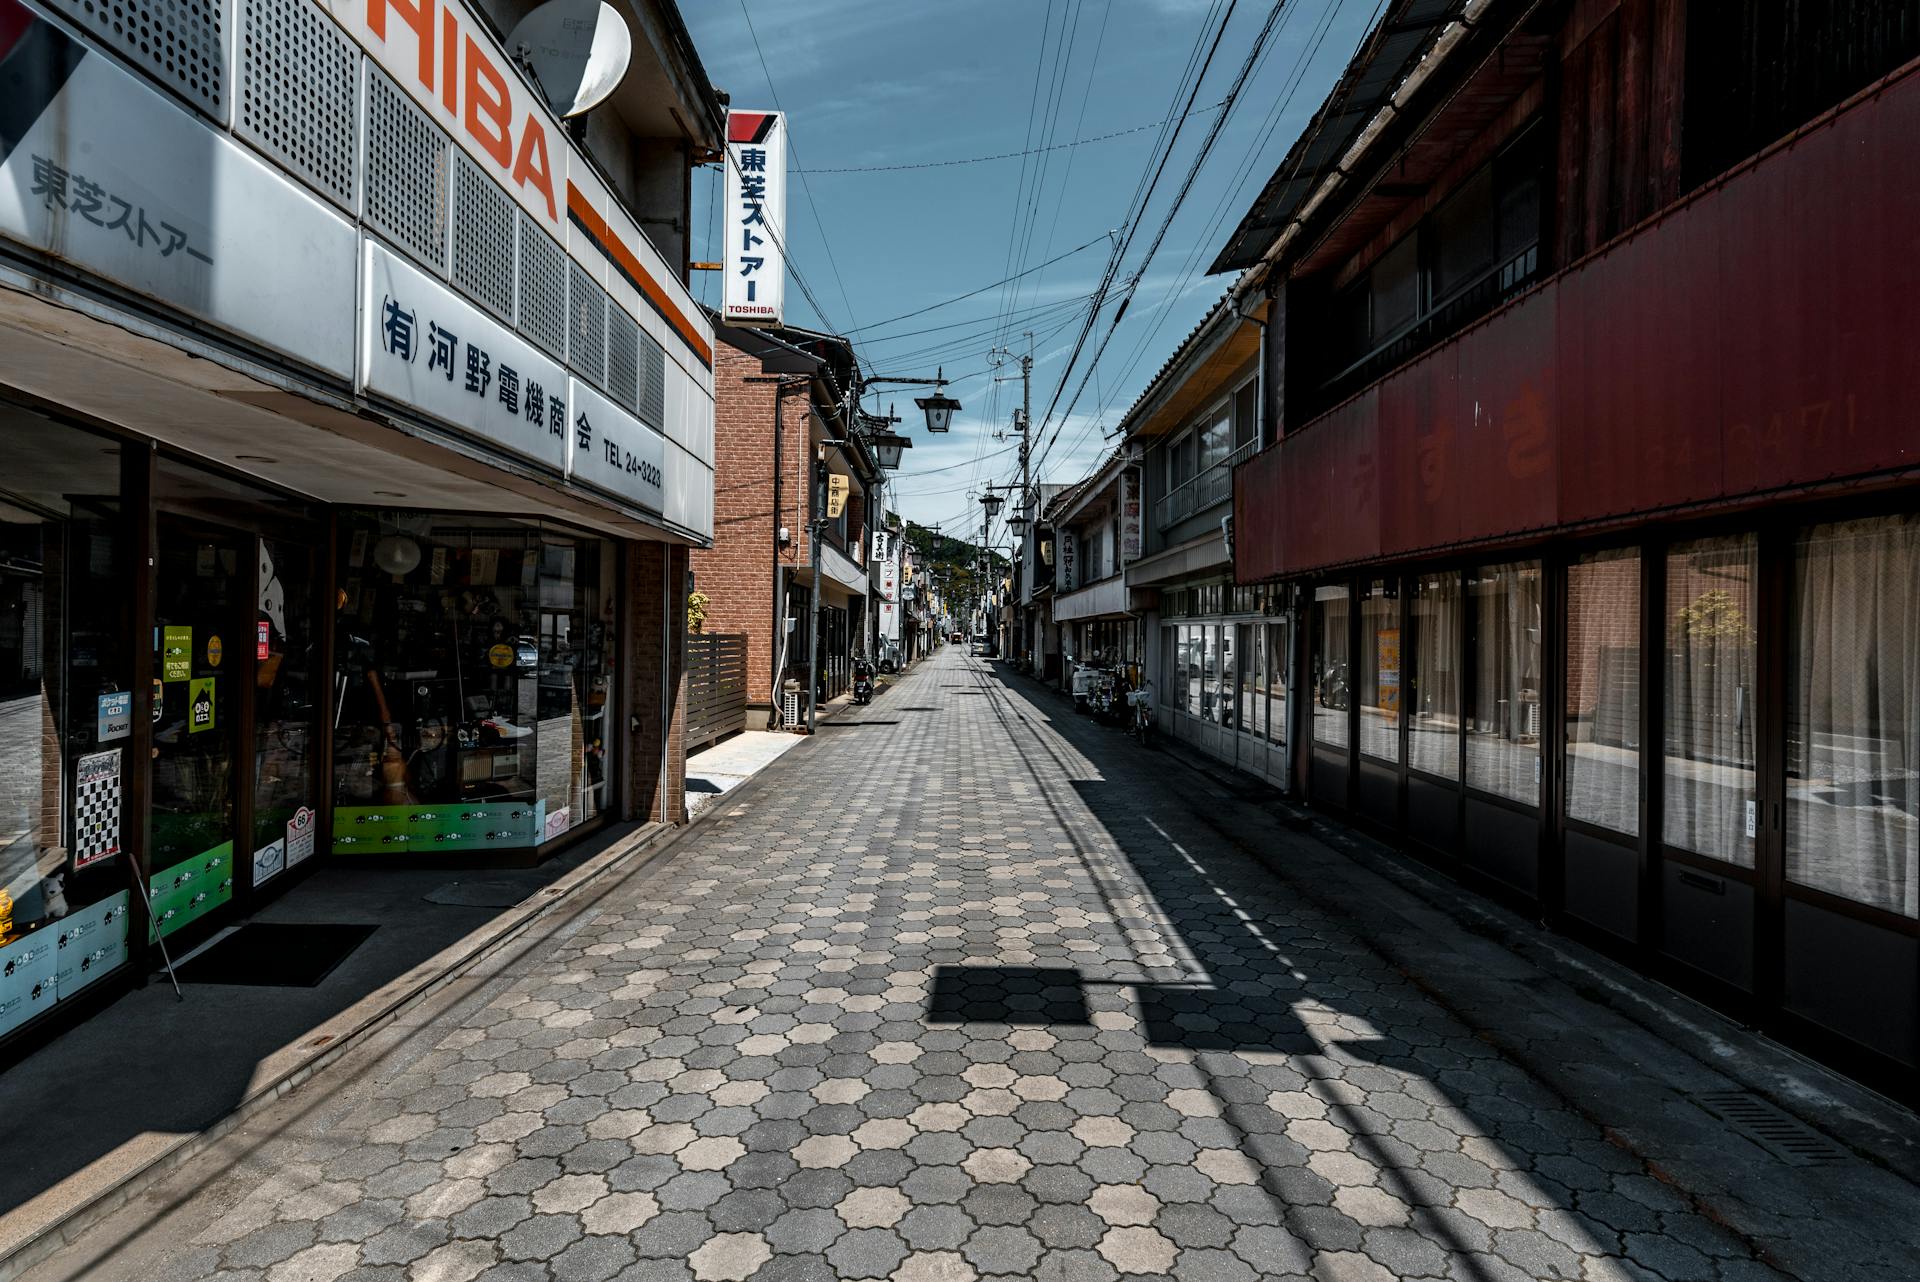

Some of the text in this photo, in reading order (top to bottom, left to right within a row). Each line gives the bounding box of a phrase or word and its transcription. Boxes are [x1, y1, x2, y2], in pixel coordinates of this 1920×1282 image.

[31, 154, 213, 265] 東芝ストアー
[740, 148, 766, 302] 東芝ストアー
[729, 305, 775, 314] TOSHIBA
[603, 439, 662, 489] TEL 24-3223
[297, 814, 306, 826] 66
